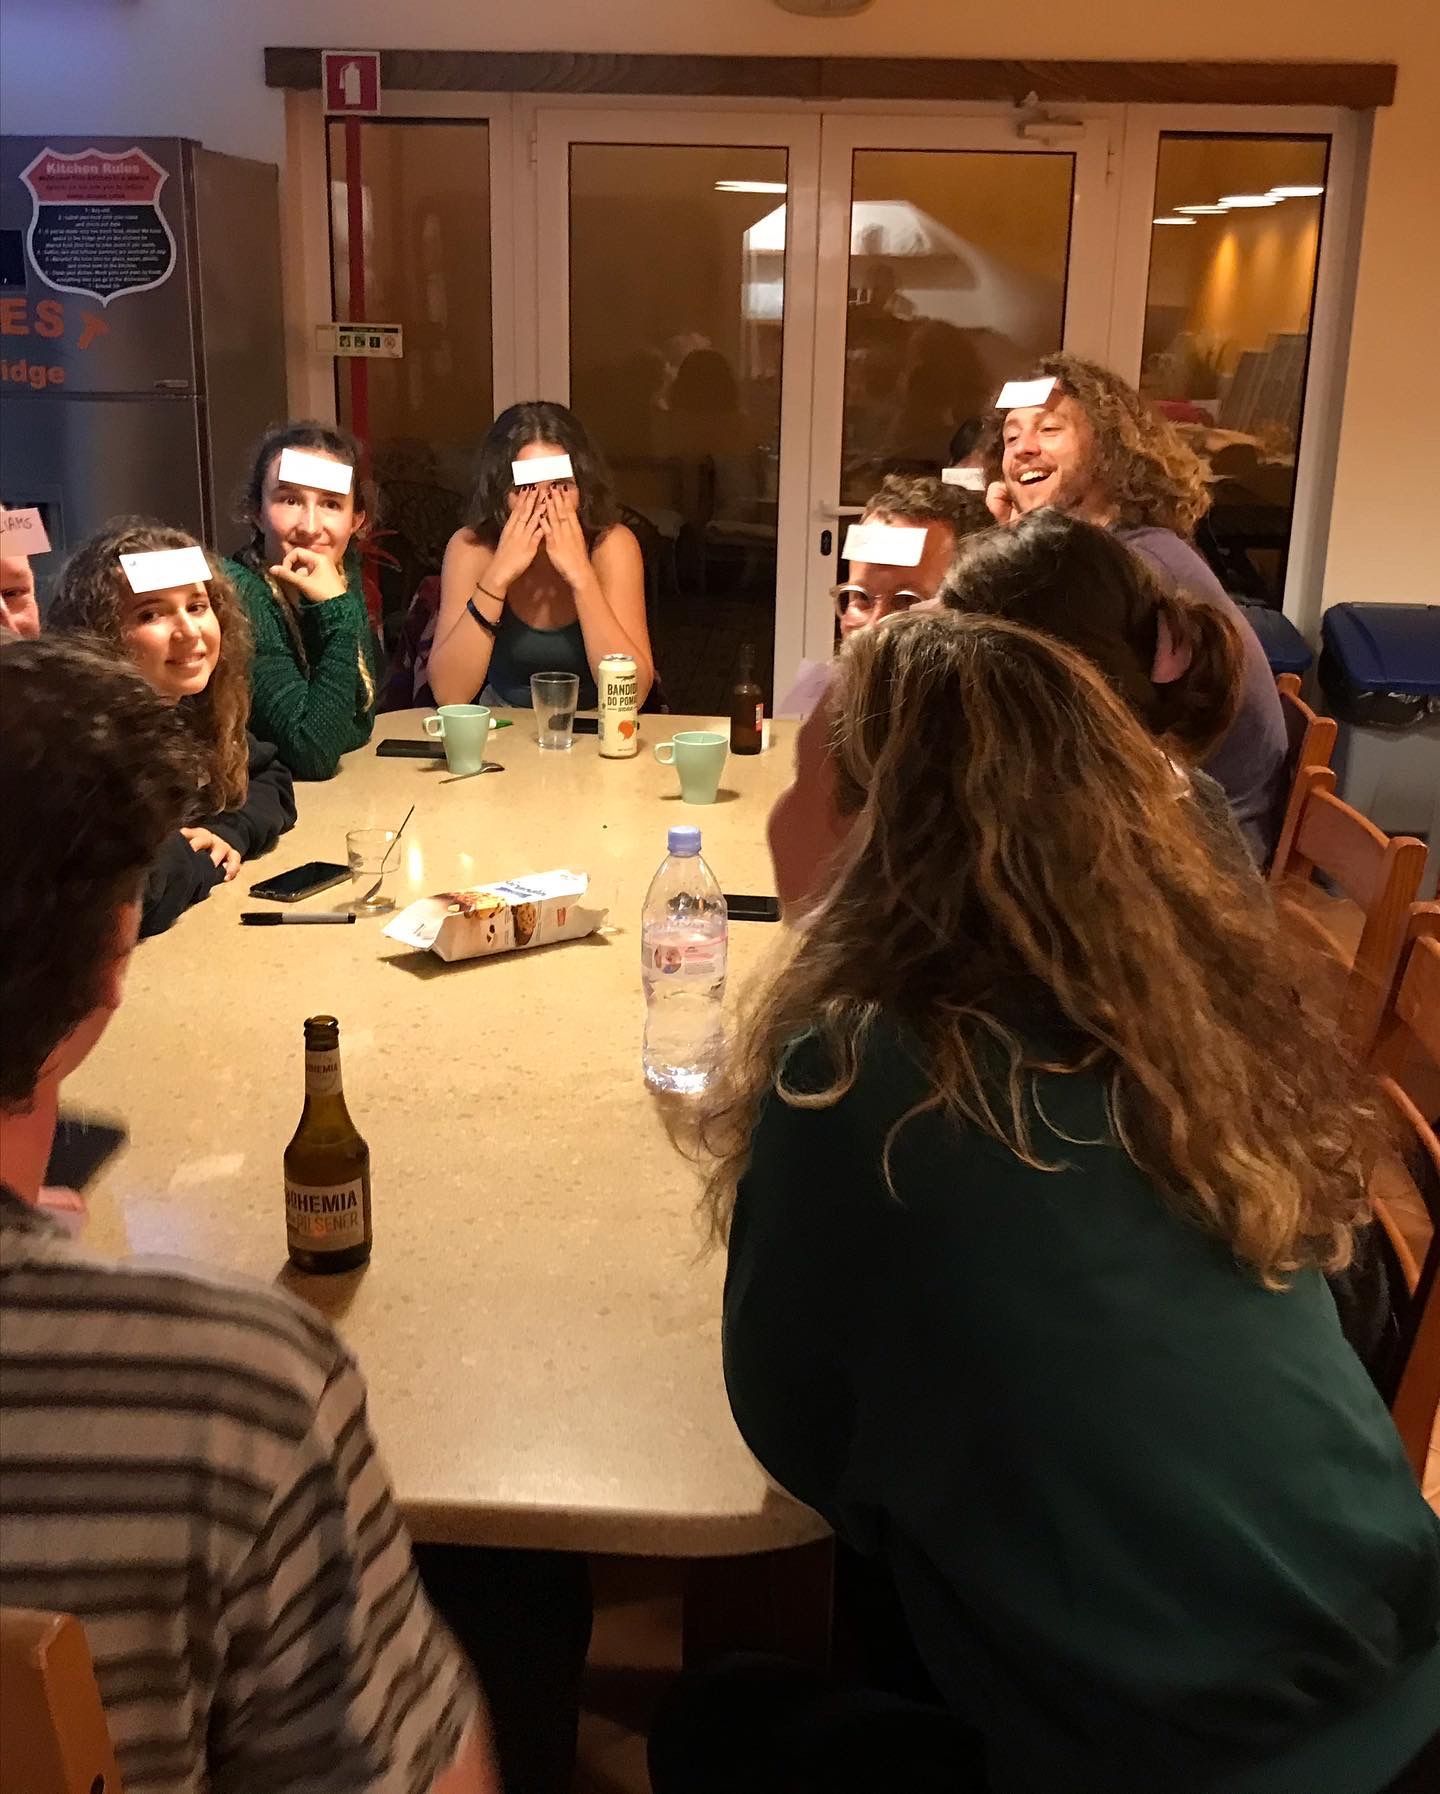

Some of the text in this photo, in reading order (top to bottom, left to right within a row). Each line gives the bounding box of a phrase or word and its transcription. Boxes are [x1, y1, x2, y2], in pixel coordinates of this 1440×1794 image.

[46, 162, 141, 174] Kitchen Rules
[607, 696, 617, 706] DO
[297, 1211, 358, 1234] PILSENER
